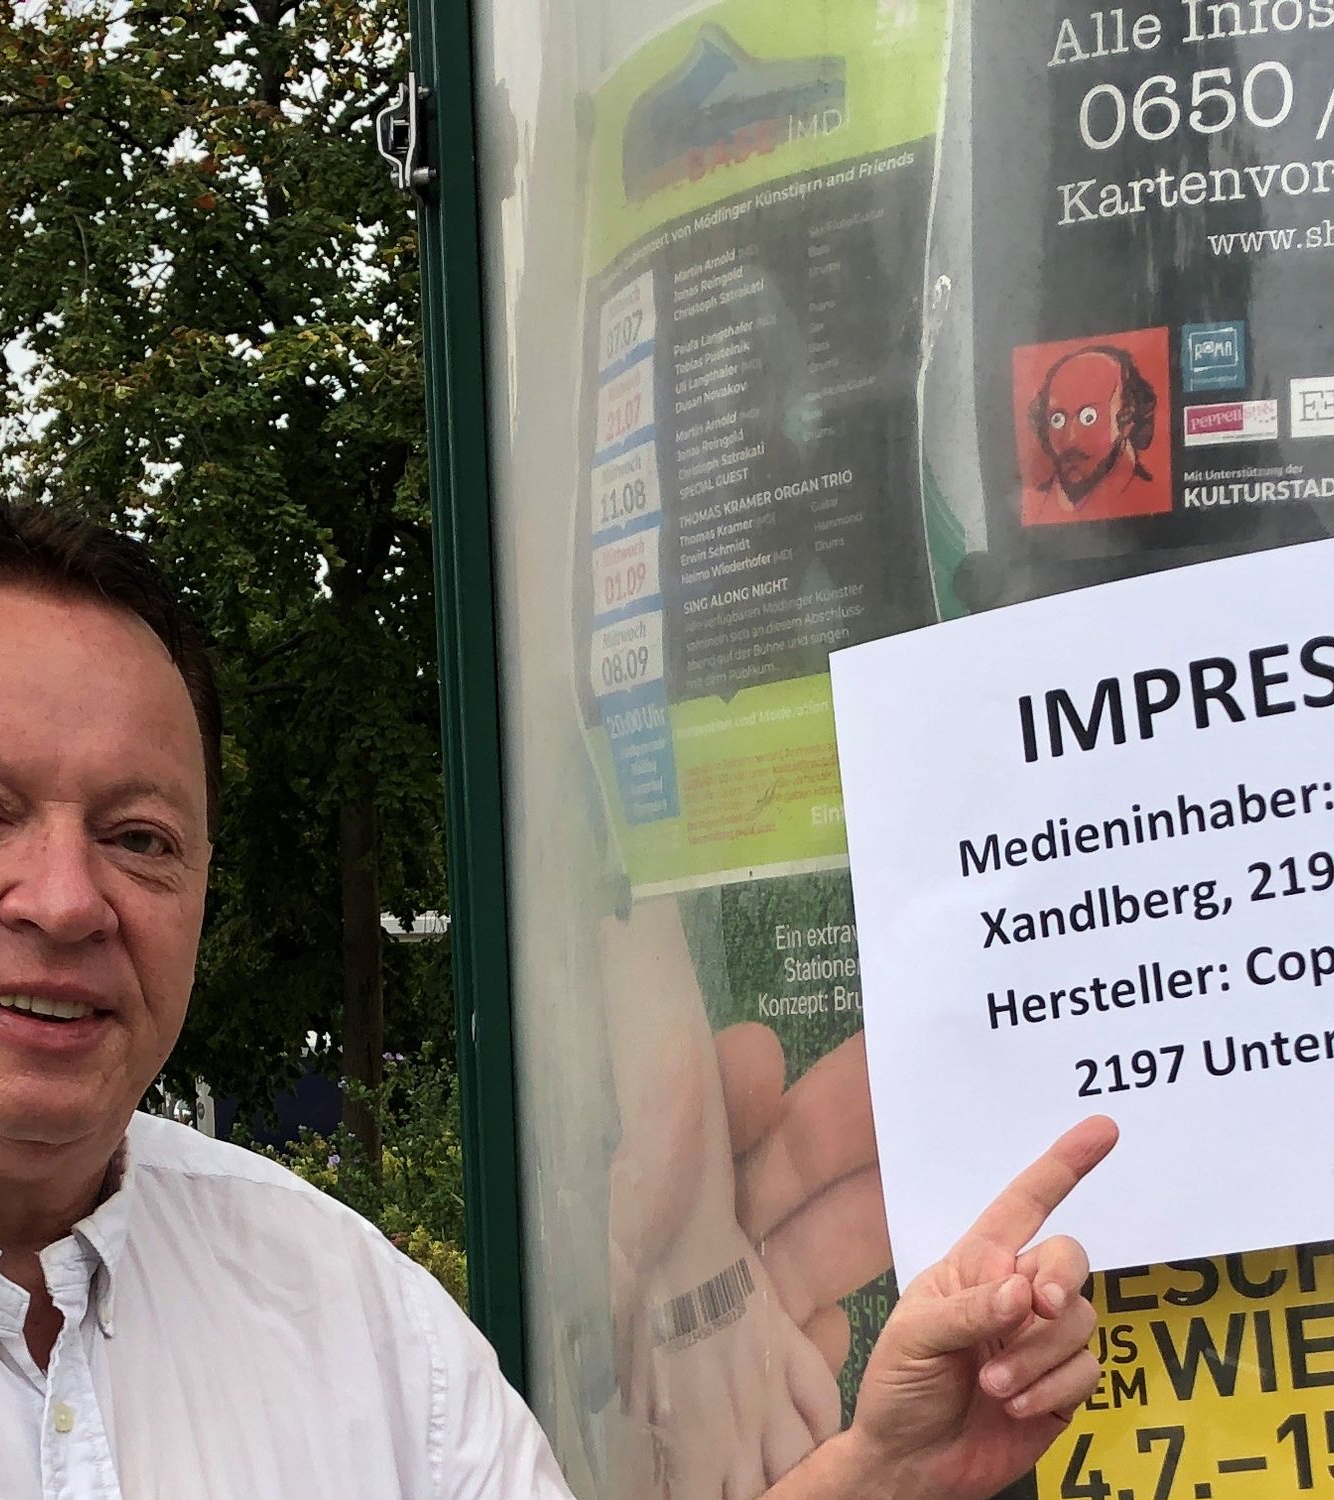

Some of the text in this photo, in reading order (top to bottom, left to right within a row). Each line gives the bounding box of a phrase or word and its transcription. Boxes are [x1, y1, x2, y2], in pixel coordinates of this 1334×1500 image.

[1047, 8, 1162, 67] Alle
[1078, 60, 1294, 150] 0650
[670, 222, 692, 243] von
[692, 198, 753, 233] Mödlinger
[826, 167, 855, 188] and
[858, 151, 915, 179] Friends
[716, 467, 749, 488] GUEST
[1183, 470, 1204, 482] Mit
[1284, 463, 1305, 476] der
[600, 478, 647, 524] 11.08
[679, 468, 854, 529] THOMAS KRAMER ORGAN TRIO
[679, 528, 716, 547] Thomas
[716, 517, 754, 538] Kramer
[708, 537, 751, 560] Schmidt
[683, 576, 789, 616] SING ALONG NIGHT
[601, 645, 649, 687] 08.09
[959, 780, 1334, 877] Medieninhaber:
[979, 878, 1233, 948] Xandlberg,
[775, 924, 802, 951] Ein
[758, 990, 829, 1019] Konzept:
[986, 960, 1232, 1030] Hersteller:
[1074, 1045, 1185, 1097] 2197
[1095, 1324, 1138, 1364] US
[1085, 1366, 1148, 1412] EM
